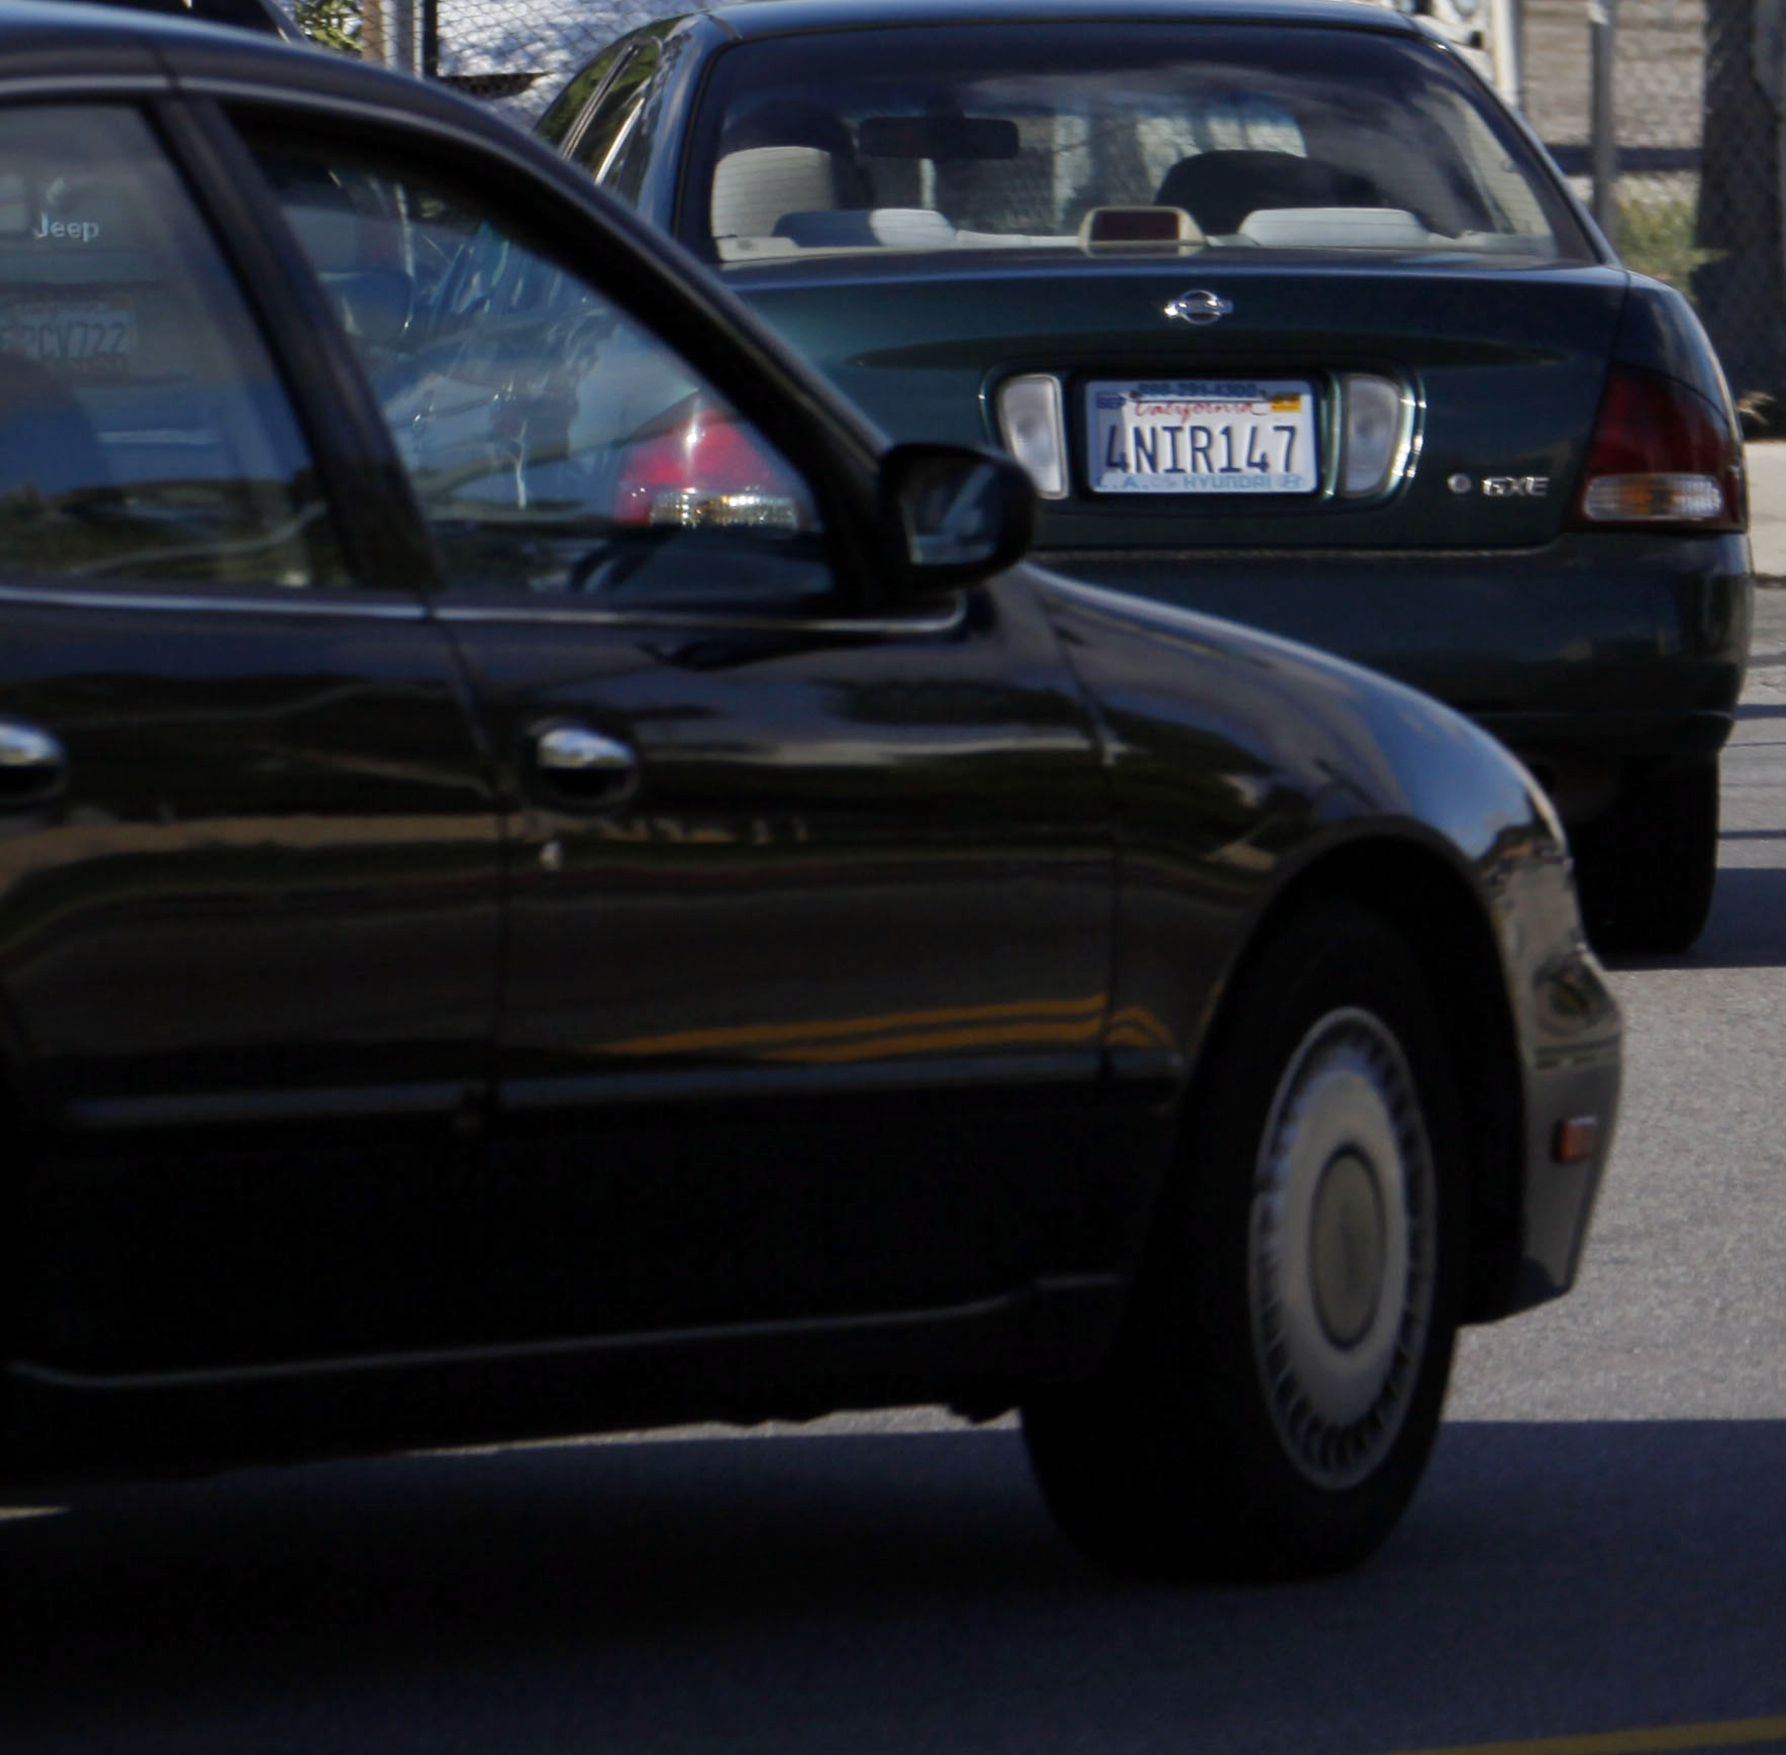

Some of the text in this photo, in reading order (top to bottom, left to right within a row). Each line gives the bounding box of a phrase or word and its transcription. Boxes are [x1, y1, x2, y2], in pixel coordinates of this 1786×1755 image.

[32, 213, 100, 242] Jeep
[1134, 400, 1269, 423] California
[1105, 425, 1297, 474] 4NIR147
[1183, 476, 1272, 489] HYUNDAI
[1482, 476, 1550, 497] GXE
